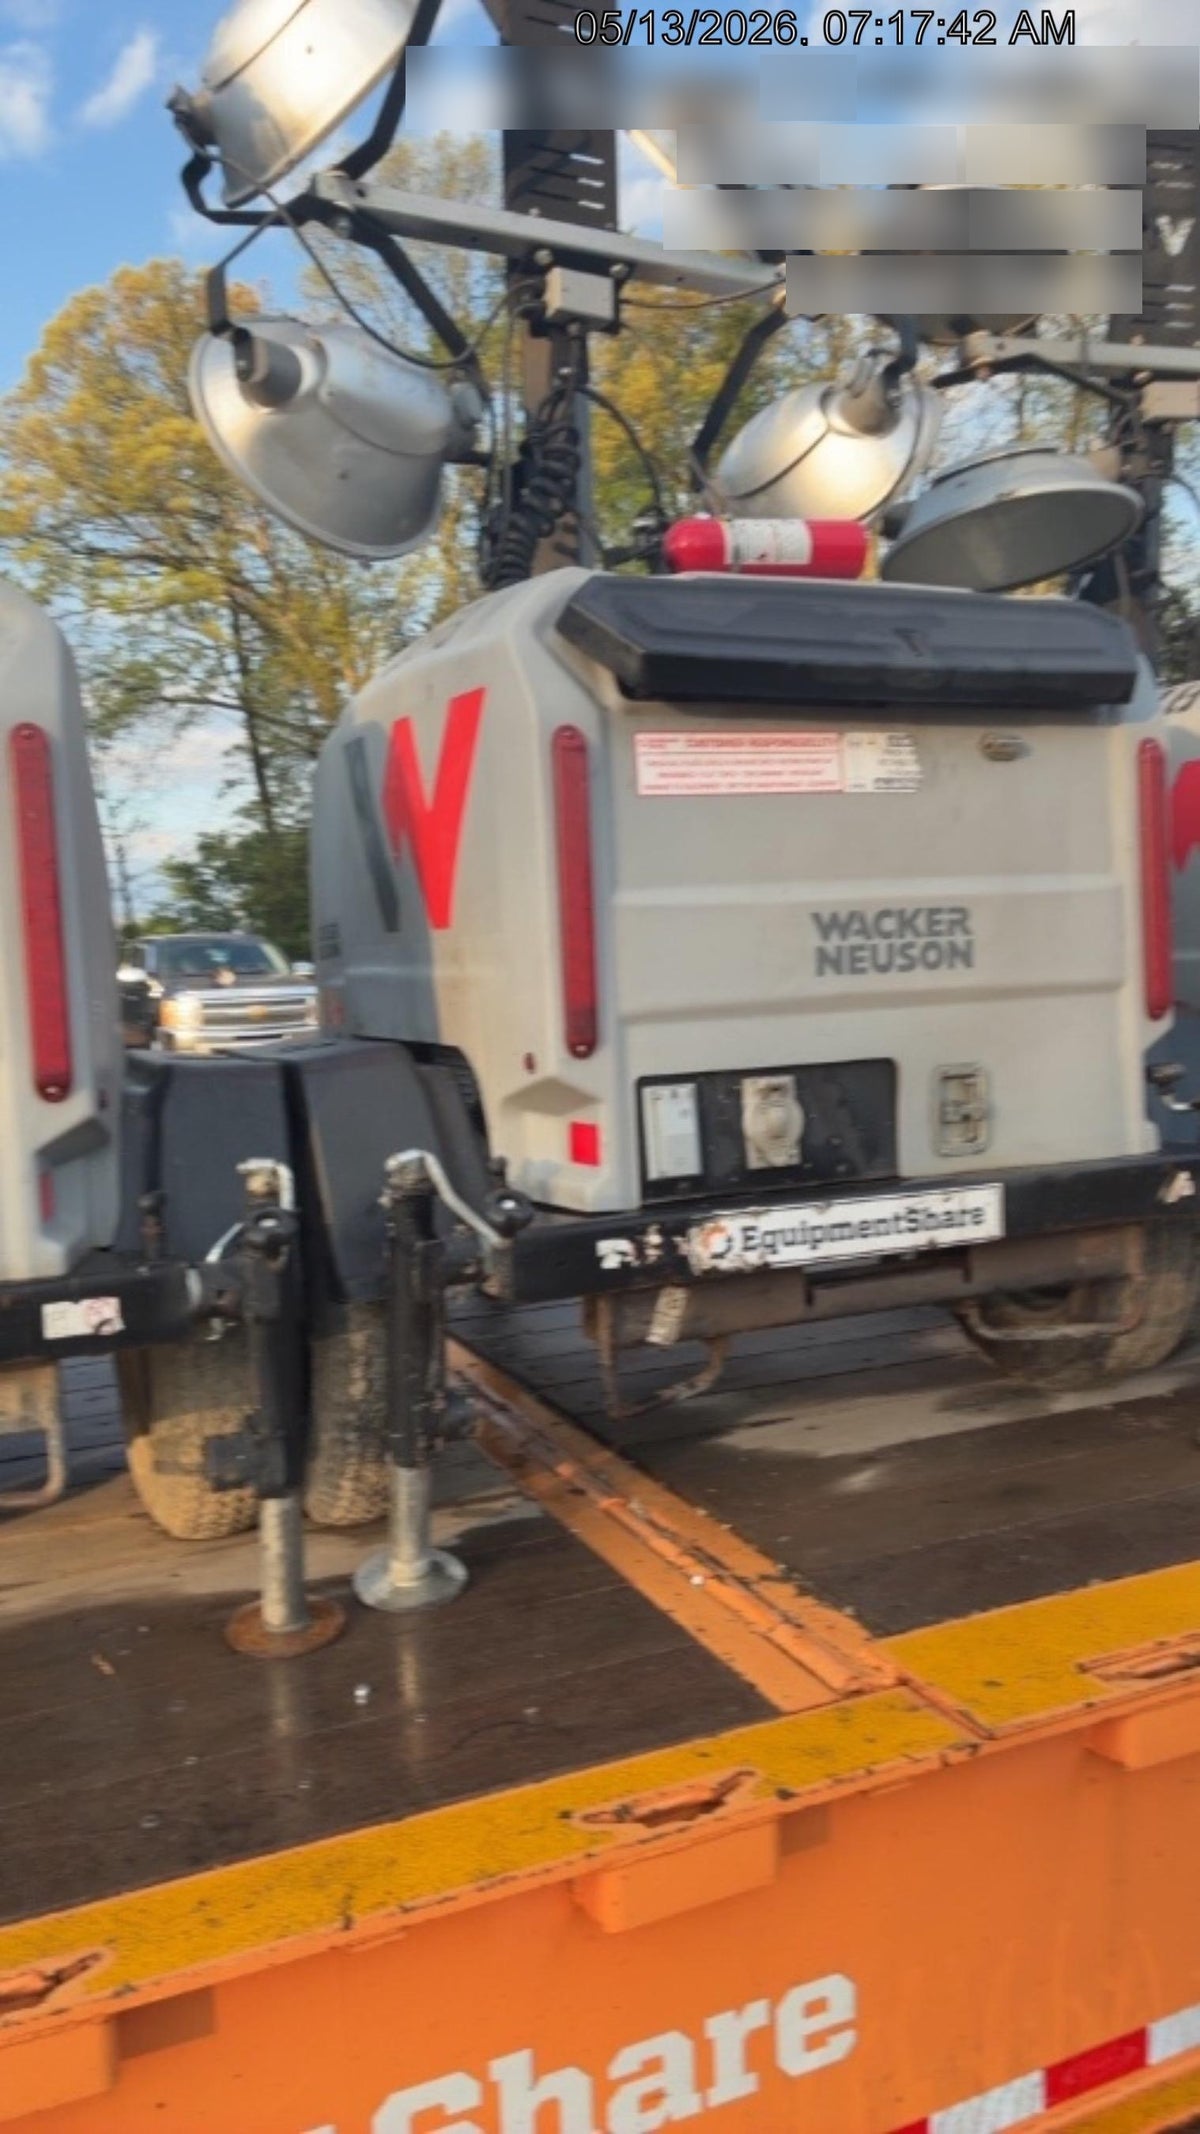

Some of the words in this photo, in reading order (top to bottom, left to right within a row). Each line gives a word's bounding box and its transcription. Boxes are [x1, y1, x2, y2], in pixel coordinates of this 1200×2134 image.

[811, 906, 974, 941] WACKER
[814, 938, 976, 978] NEUSON
[741, 1206, 984, 1255] EquipmentShare
